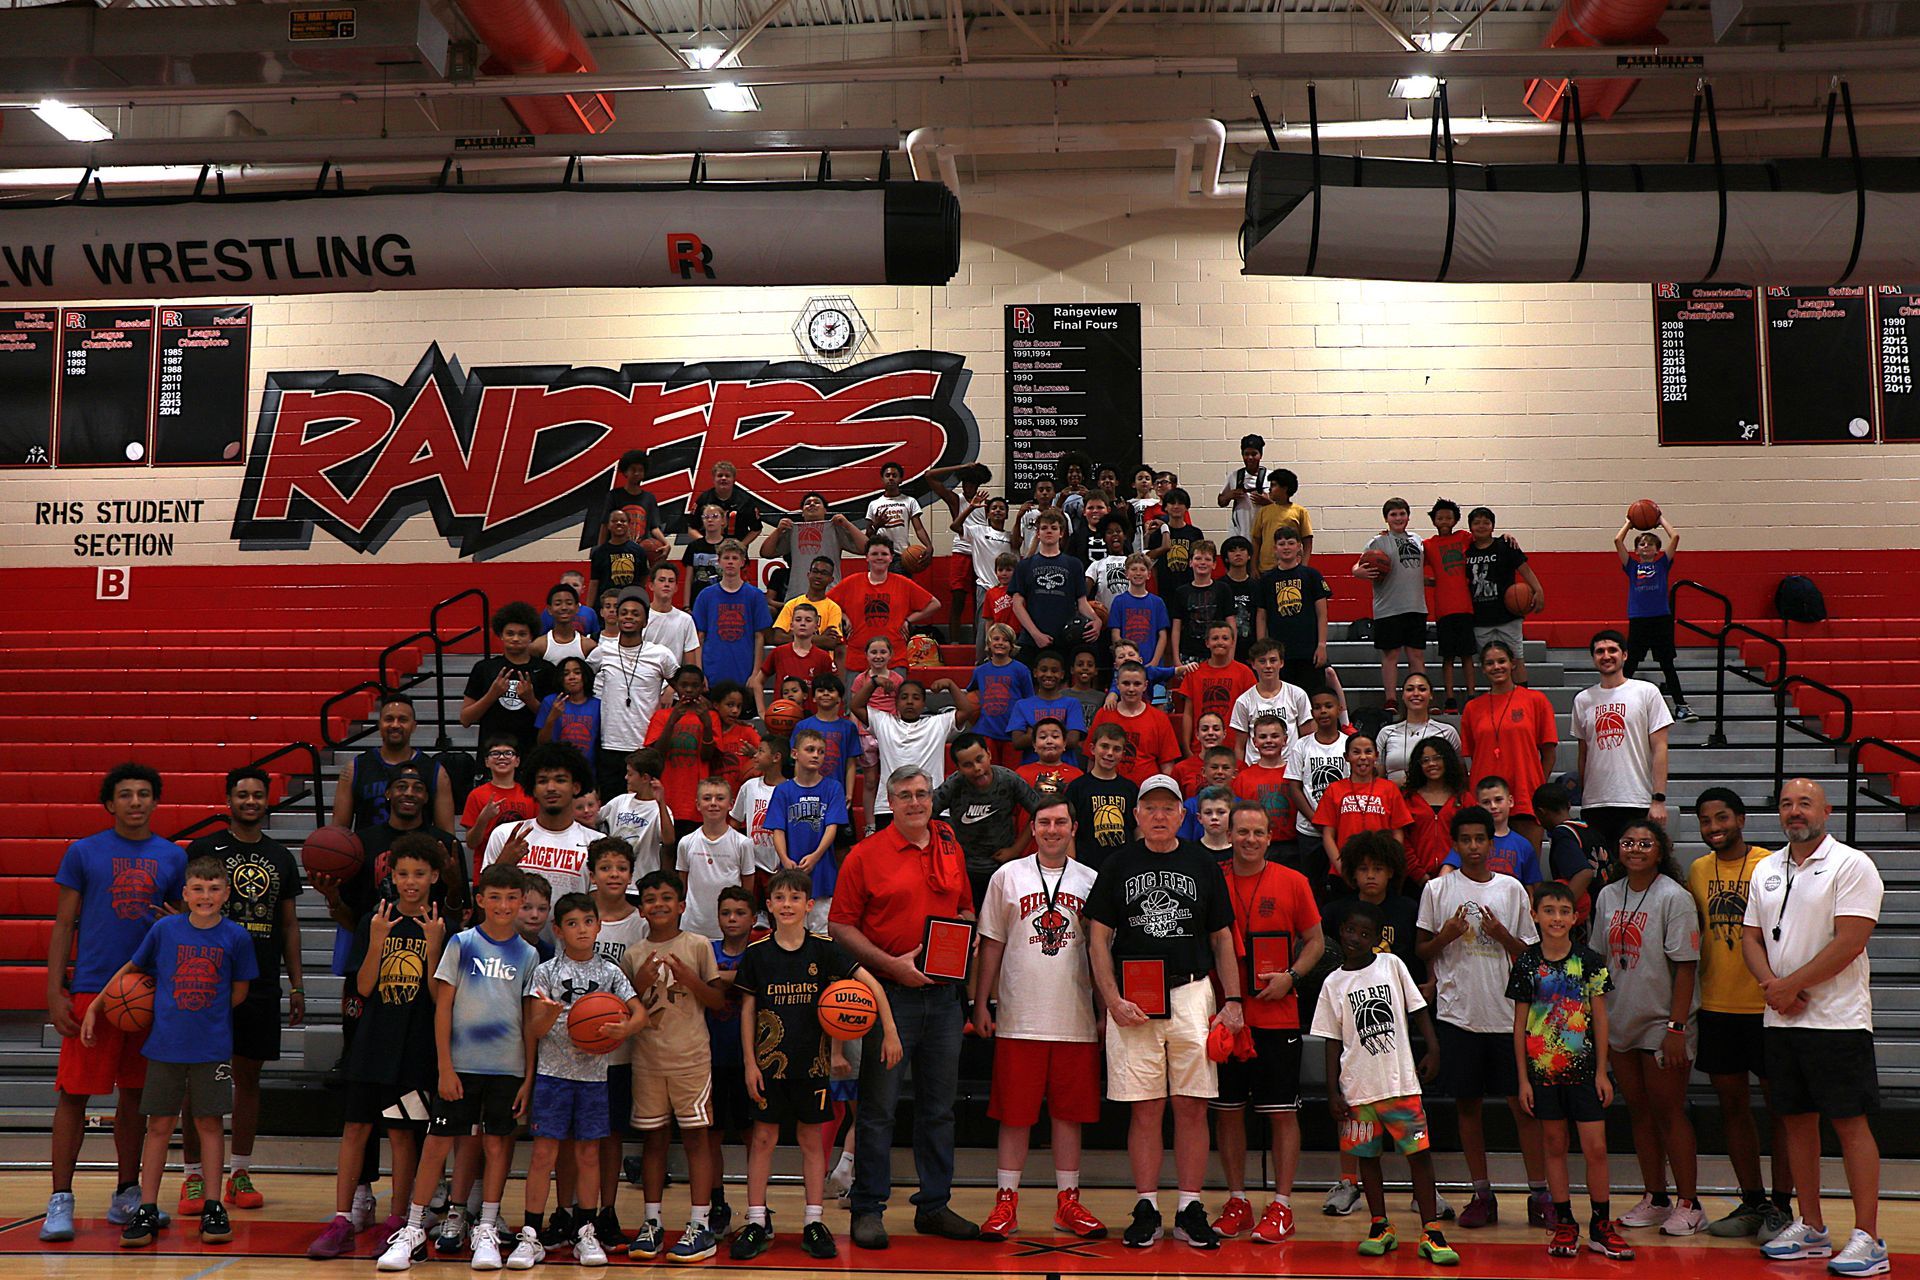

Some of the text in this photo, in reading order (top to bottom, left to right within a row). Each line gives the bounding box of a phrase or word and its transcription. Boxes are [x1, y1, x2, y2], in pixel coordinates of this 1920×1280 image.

[0, 233, 416, 288] W WRESTLING
[1692, 288, 1753, 298] Cheerleading
[1687, 301, 1724, 311] League
[1796, 299, 1835, 309] League
[1054, 307, 1118, 318] Rangeview
[1677, 310, 1735, 320] Champions
[1786, 308, 1846, 319] Champions
[115, 318, 151, 328] Baseball
[213, 316, 247, 326] Football
[1054, 320, 1118, 330] Final Fours
[1662, 322, 1684, 330] 2008
[1772, 320, 1794, 328] 1987
[90, 330, 124, 340] League
[187, 328, 220, 338] League
[81, 340, 133, 350] Champions
[177, 338, 230, 348] Champions
[1882, 337, 1907, 345] 2012
[1882, 346, 1908, 354] 2013
[1662, 357, 1686, 365] 2013
[1882, 355, 1909, 364] 2014
[1662, 366, 1686, 375] 2014
[1883, 365, 1910, 374] 2015
[1662, 376, 1687, 384] 2016
[1883, 375, 1911, 384] 2016
[1662, 385, 1688, 393] 2017
[1884, 384, 1912, 394] 2017
[1663, 393, 1688, 401] 2021
[159, 407, 180, 415] 2014
[245, 355, 957, 541] RAIDERS
[36, 500, 205, 525] RHS STUDENT
[74, 533, 174, 556] SECTION
[102, 568, 125, 597] B
[1275, 579, 1302, 591] BIG RED
[1271, 706, 1287, 720] RED
[1595, 703, 1626, 719] BIG RED
[1310, 756, 1344, 773] BIG RED
[1092, 795, 1126, 813] BIG RED
[1342, 794, 1382, 805] AURORA
[967, 804, 992, 816] NIKE
[521, 845, 586, 872] ANGEVIEW
[135, 858, 158, 879] RED
[1125, 870, 1197, 905] BIG RED
[1707, 880, 1724, 900] BIG
[1728, 880, 1750, 902] RED
[1020, 892, 1087, 920] BIG RED
[1128, 908, 1193, 927] BASKETBALL
[1144, 921, 1178, 934] CAMP
[1382, 926, 1395, 944] ED
[382, 936, 428, 962] BIG RED
[604, 942, 626, 963] RED
[200, 945, 224, 969] RED
[471, 957, 517, 981] Nike
[767, 982, 818, 996] Emirates
[774, 994, 812, 1005] FLY BETTER
[836, 992, 872, 1008] Wilson
[1348, 984, 1392, 1014] BIG RED
[838, 1013, 868, 1025] NCAA
[814, 1088, 827, 1110] 7
